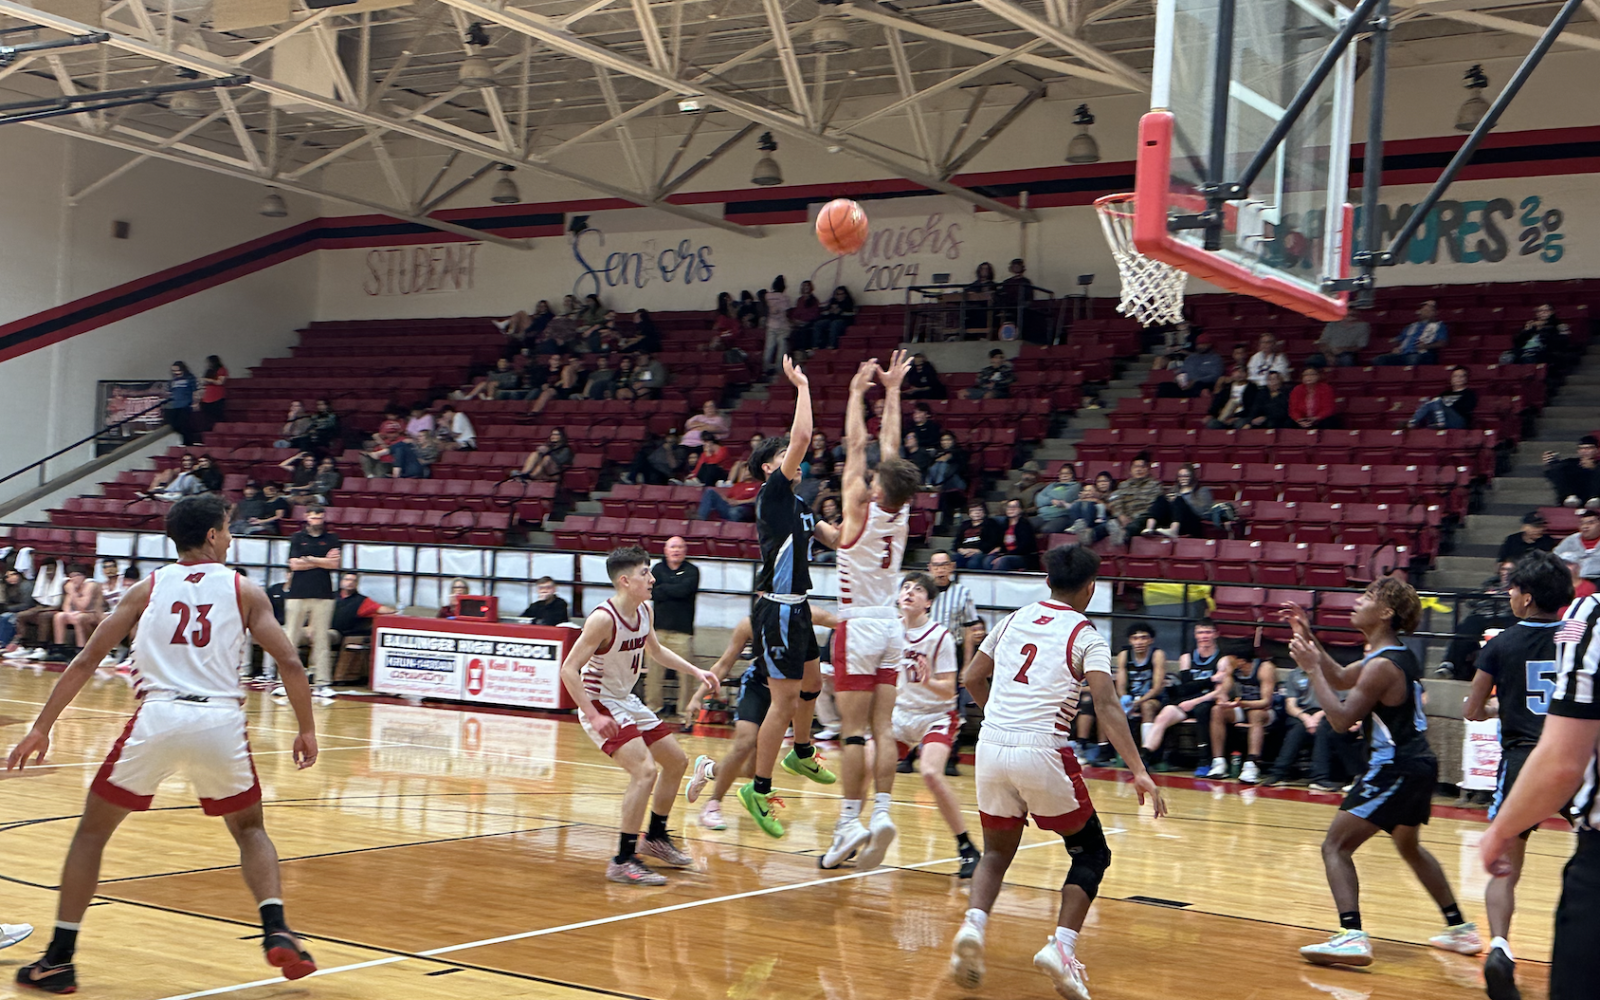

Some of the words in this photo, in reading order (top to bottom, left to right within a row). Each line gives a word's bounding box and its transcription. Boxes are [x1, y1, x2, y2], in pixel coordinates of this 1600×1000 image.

[363, 242, 482, 297] STUDENT
[864, 262, 920, 293] 2024
[169, 601, 214, 648] 23
[383, 634, 456, 652] BALLINGER
[458, 640, 494, 655] HIGH
[496, 643, 552, 659] SCHOOL
[630, 653, 641, 675] 4
[1013, 643, 1038, 685] 2
[1525, 661, 1557, 715] 5
